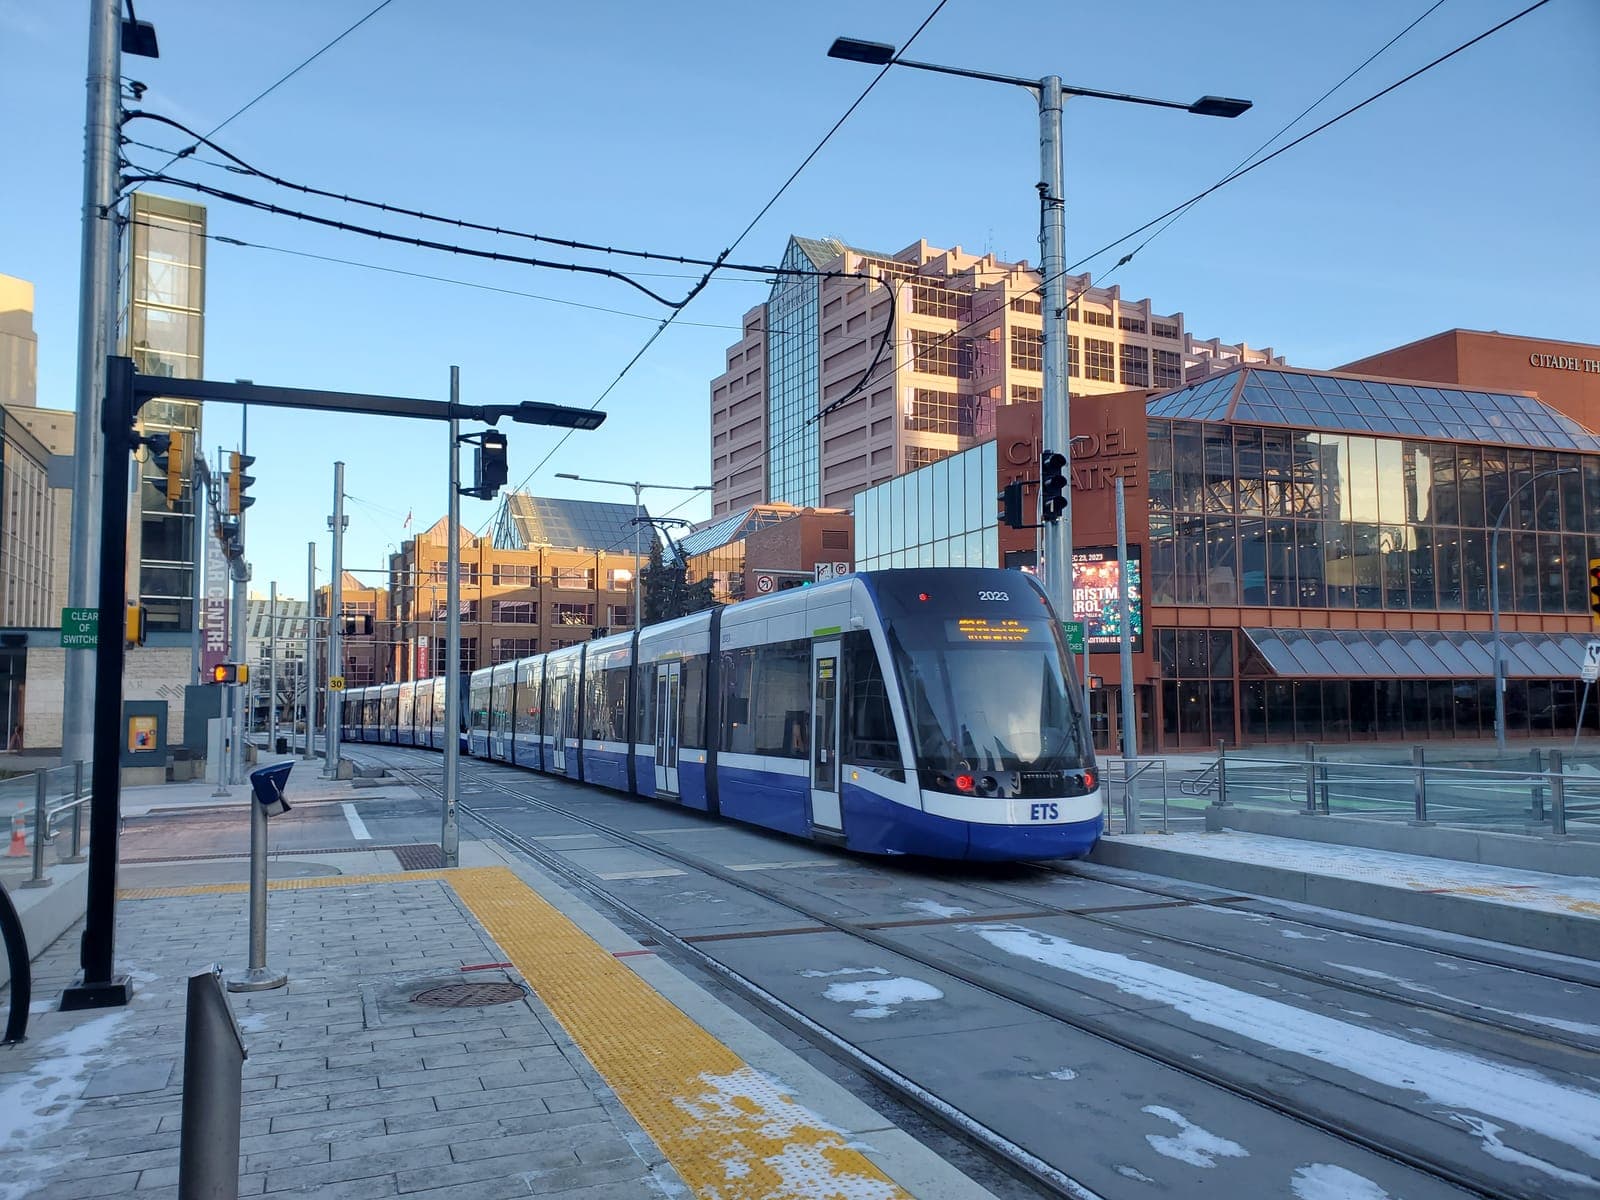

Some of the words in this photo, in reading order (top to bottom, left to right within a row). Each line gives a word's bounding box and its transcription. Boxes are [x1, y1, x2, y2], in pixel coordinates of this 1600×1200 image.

[1529, 353, 1581, 371] CITADEL
[1006, 427, 1139, 465] CIDEL
[978, 591, 1010, 601] 2023
[1073, 587, 1137, 601] RISTMS
[1073, 600, 1102, 612] ROL
[71, 611, 99, 621] CLEAR
[207, 586, 226, 652] CENTRE
[78, 623, 91, 632] OF
[330, 680, 342, 688] 30
[1030, 803, 1059, 821] ETS
